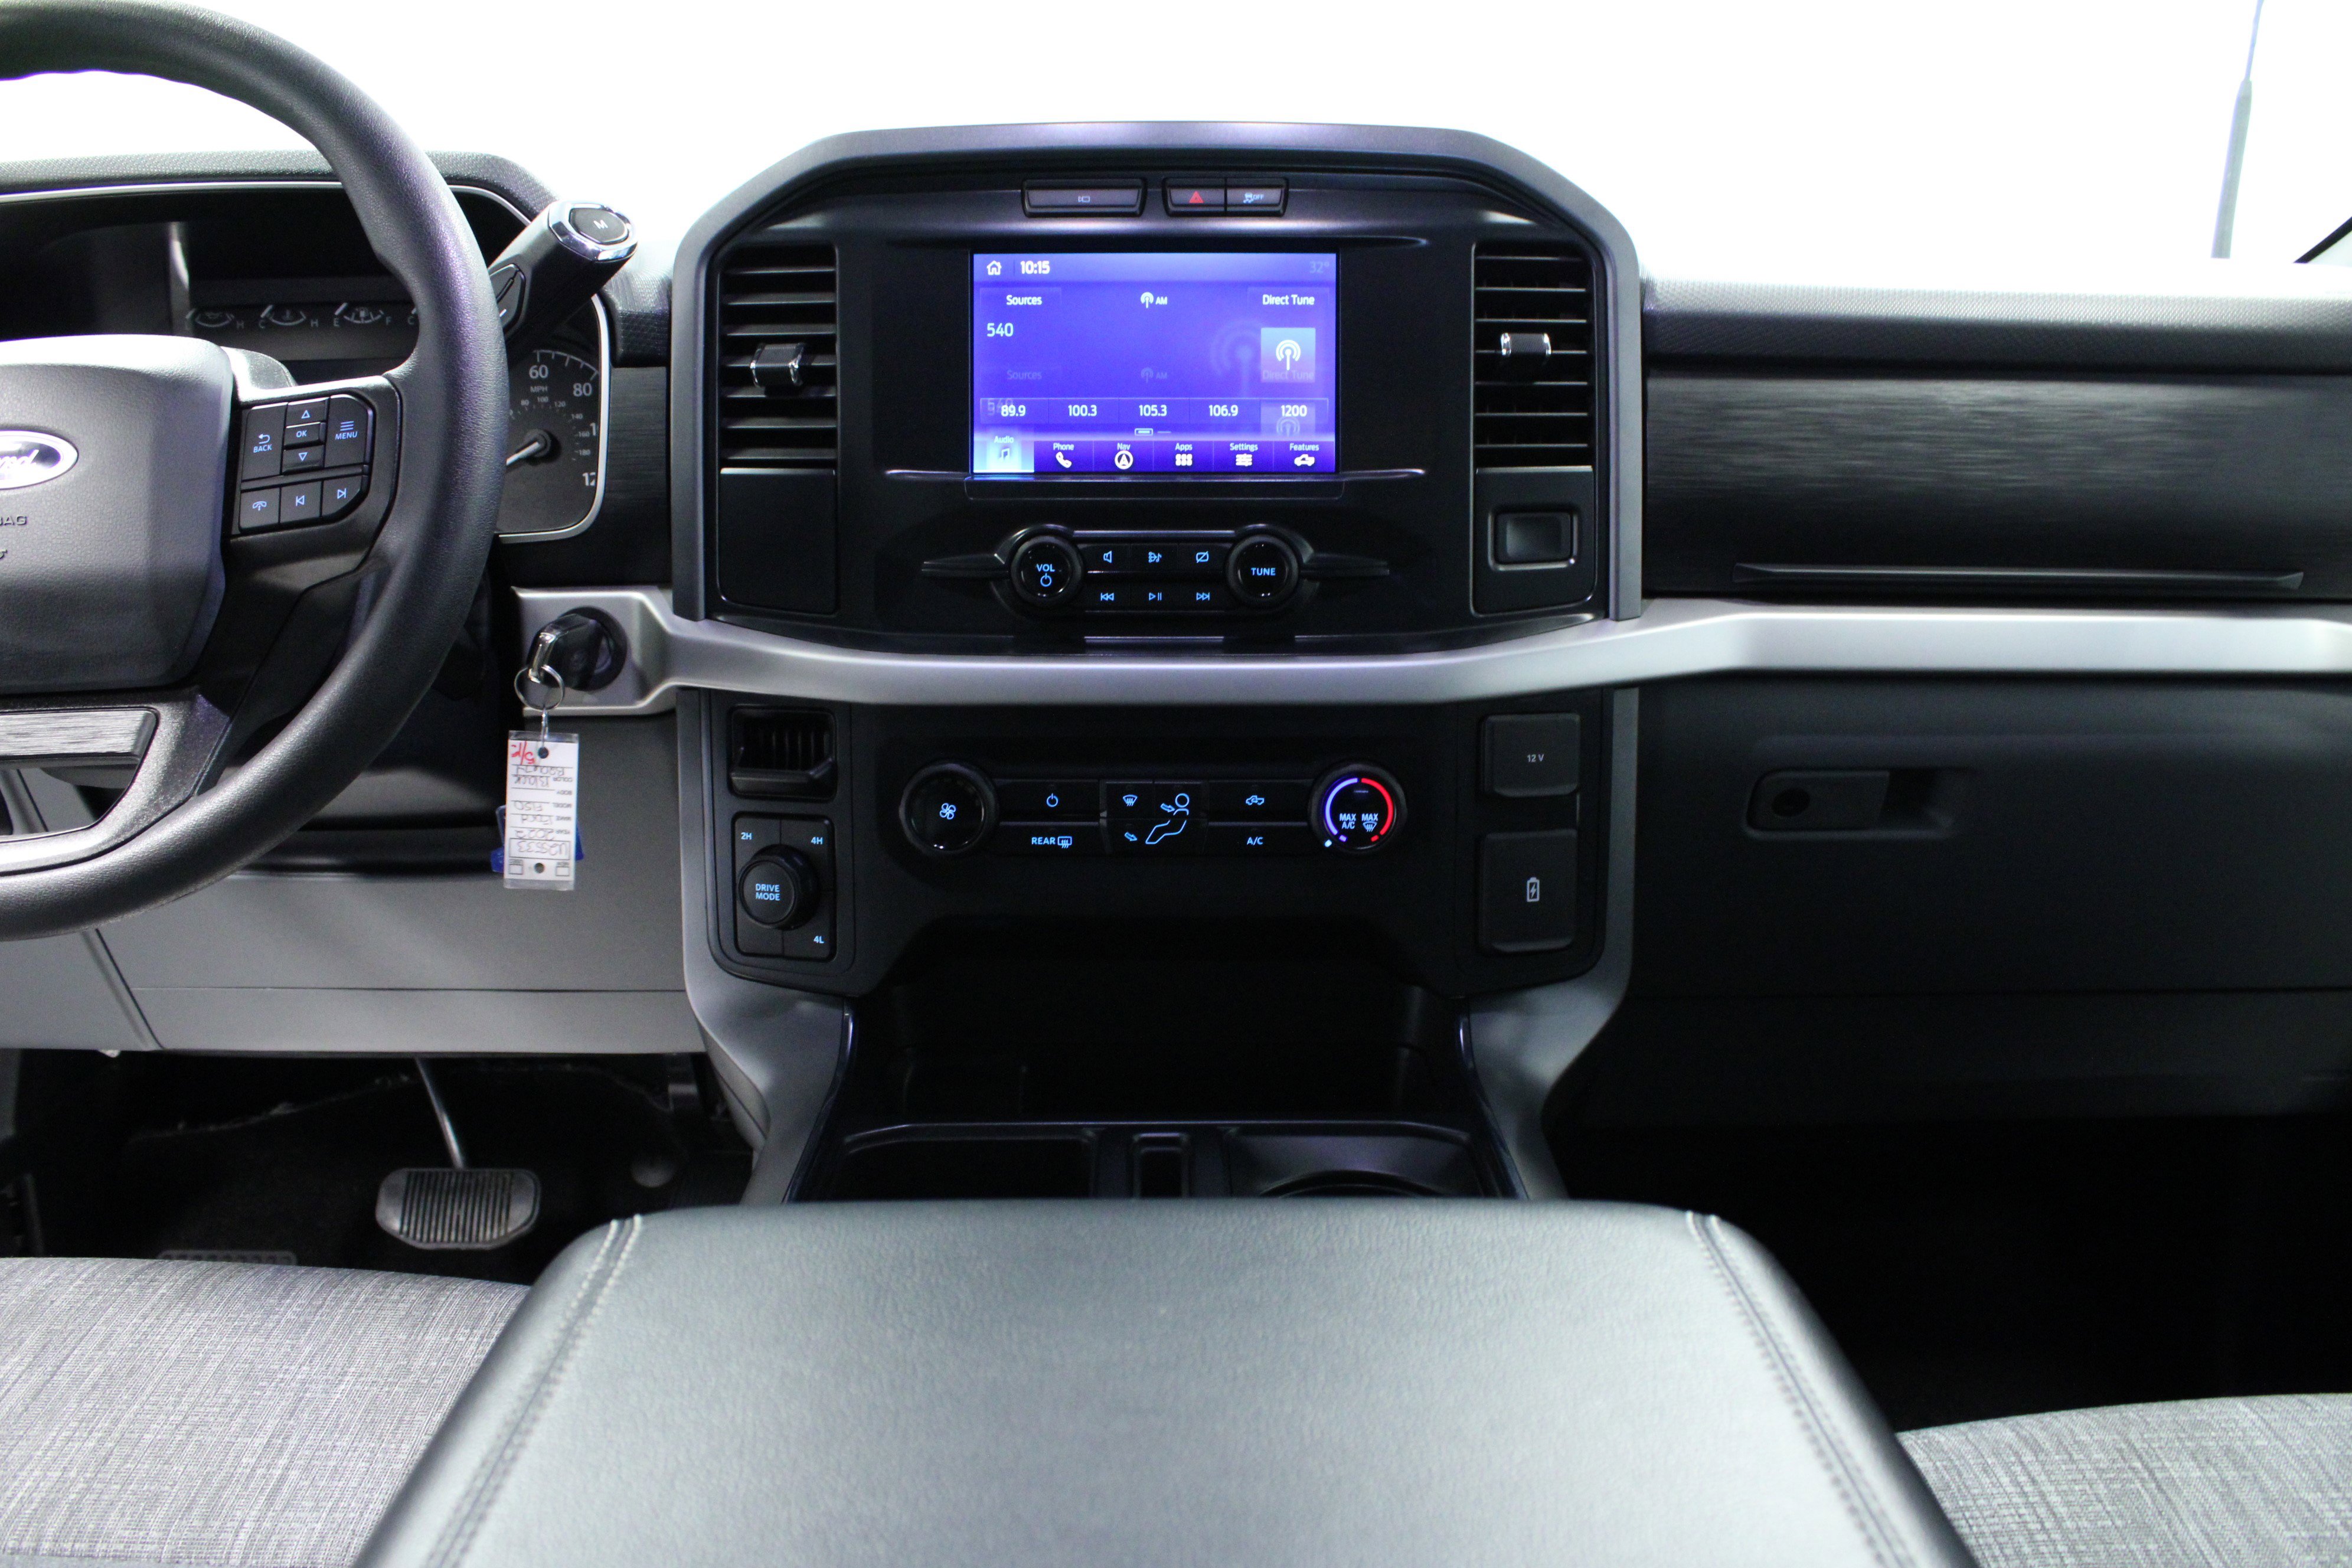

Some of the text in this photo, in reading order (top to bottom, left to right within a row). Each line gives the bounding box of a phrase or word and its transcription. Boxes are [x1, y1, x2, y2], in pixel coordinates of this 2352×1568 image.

[593, 219, 609, 230] M
[1020, 260, 1050, 275] 10:15
[1006, 294, 1043, 306] Sources
[1155, 296, 1168, 305] AM
[1262, 294, 1315, 305] Direct Tune
[311, 319, 319, 328] H
[986, 323, 1014, 337] 540
[529, 365, 548, 379] 60
[573, 383, 592, 397] 80
[1001, 405, 1026, 417] 89.9
[1068, 405, 1097, 417] 100.3
[1139, 405, 1168, 417] 105.3
[1208, 405, 1239, 417] 106.9
[1280, 405, 1308, 417] 1200
[296, 430, 307, 438] OK
[335, 431, 358, 440] MENU
[994, 436, 1014, 444] Audio
[253, 444, 272, 453] BACK
[1053, 443, 1074, 451] Phone
[1117, 443, 1131, 451] Nav
[1175, 443, 1193, 452] Apps
[1229, 443, 1259, 453] Settings
[1289, 443, 1319, 451] Features
[1036, 563, 1055, 572] VOL
[1251, 567, 1276, 576] TUNE
[1527, 754, 1544, 763] 12 V
[1339, 813, 1357, 821] MAX
[1361, 813, 1379, 821] MAX
[1341, 821, 1355, 829] A/C
[740, 832, 753, 840] 2H
[811, 837, 823, 845] 4H
[1031, 837, 1056, 845] REAR
[1246, 837, 1263, 845] A/C
[755, 883, 780, 892] DRIVE
[755, 892, 780, 901] MODE
[813, 935, 825, 944] 4L
